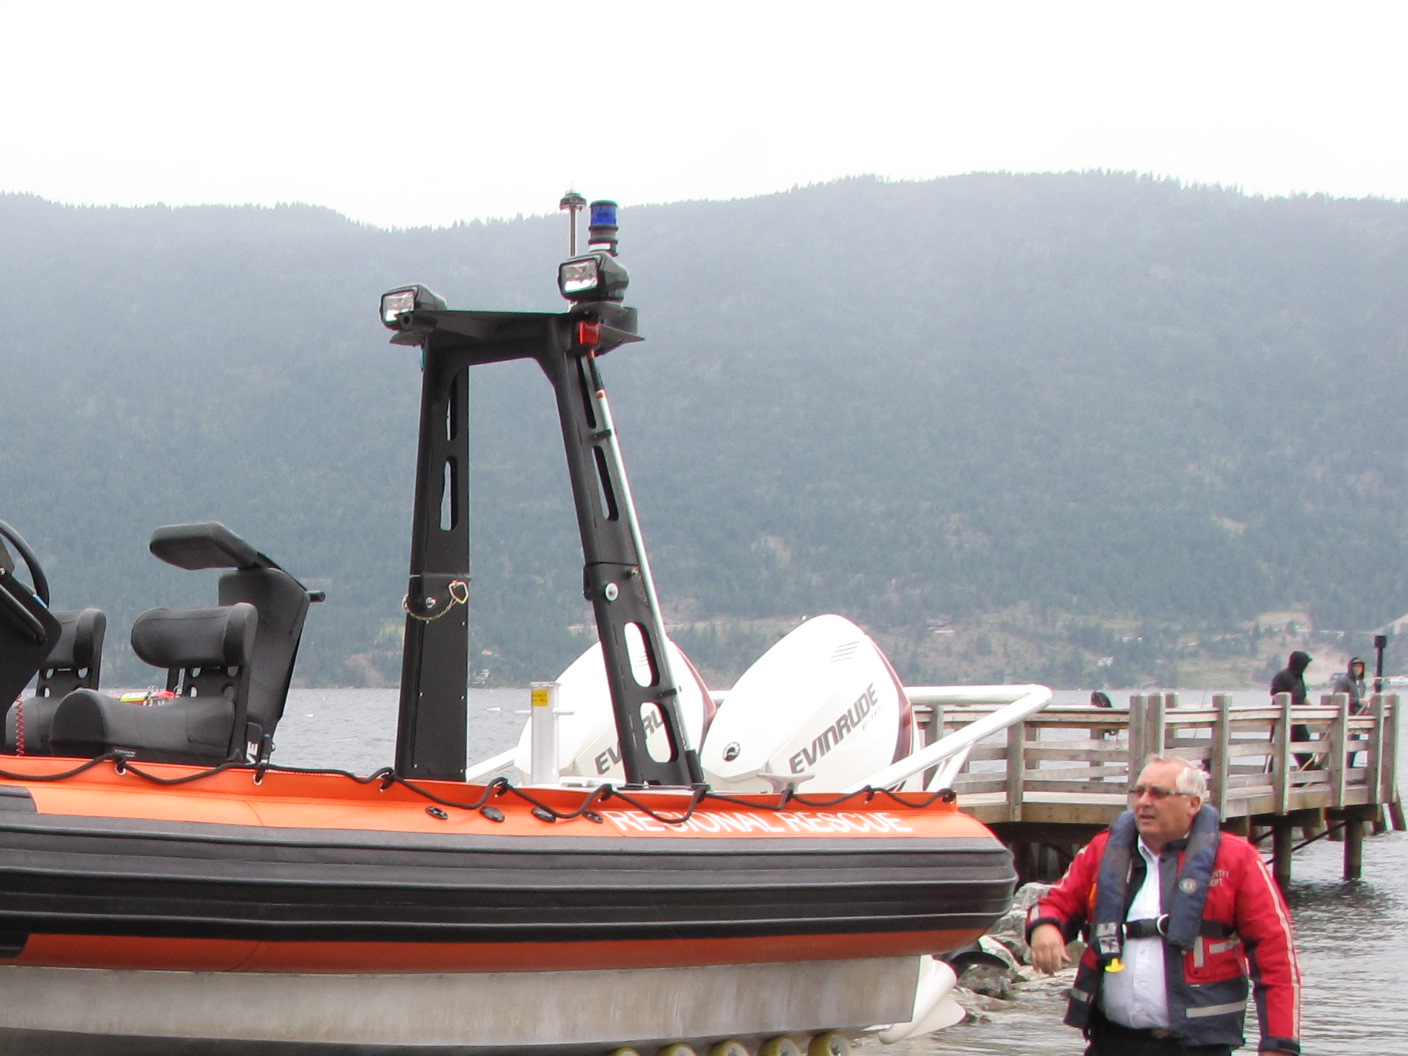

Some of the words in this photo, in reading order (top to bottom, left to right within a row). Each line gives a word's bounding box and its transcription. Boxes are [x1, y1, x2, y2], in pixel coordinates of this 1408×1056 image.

[789, 682, 879, 774] EVINRUDE
[600, 810, 786, 833] REGIONAL
[774, 811, 913, 833] RESCUE
